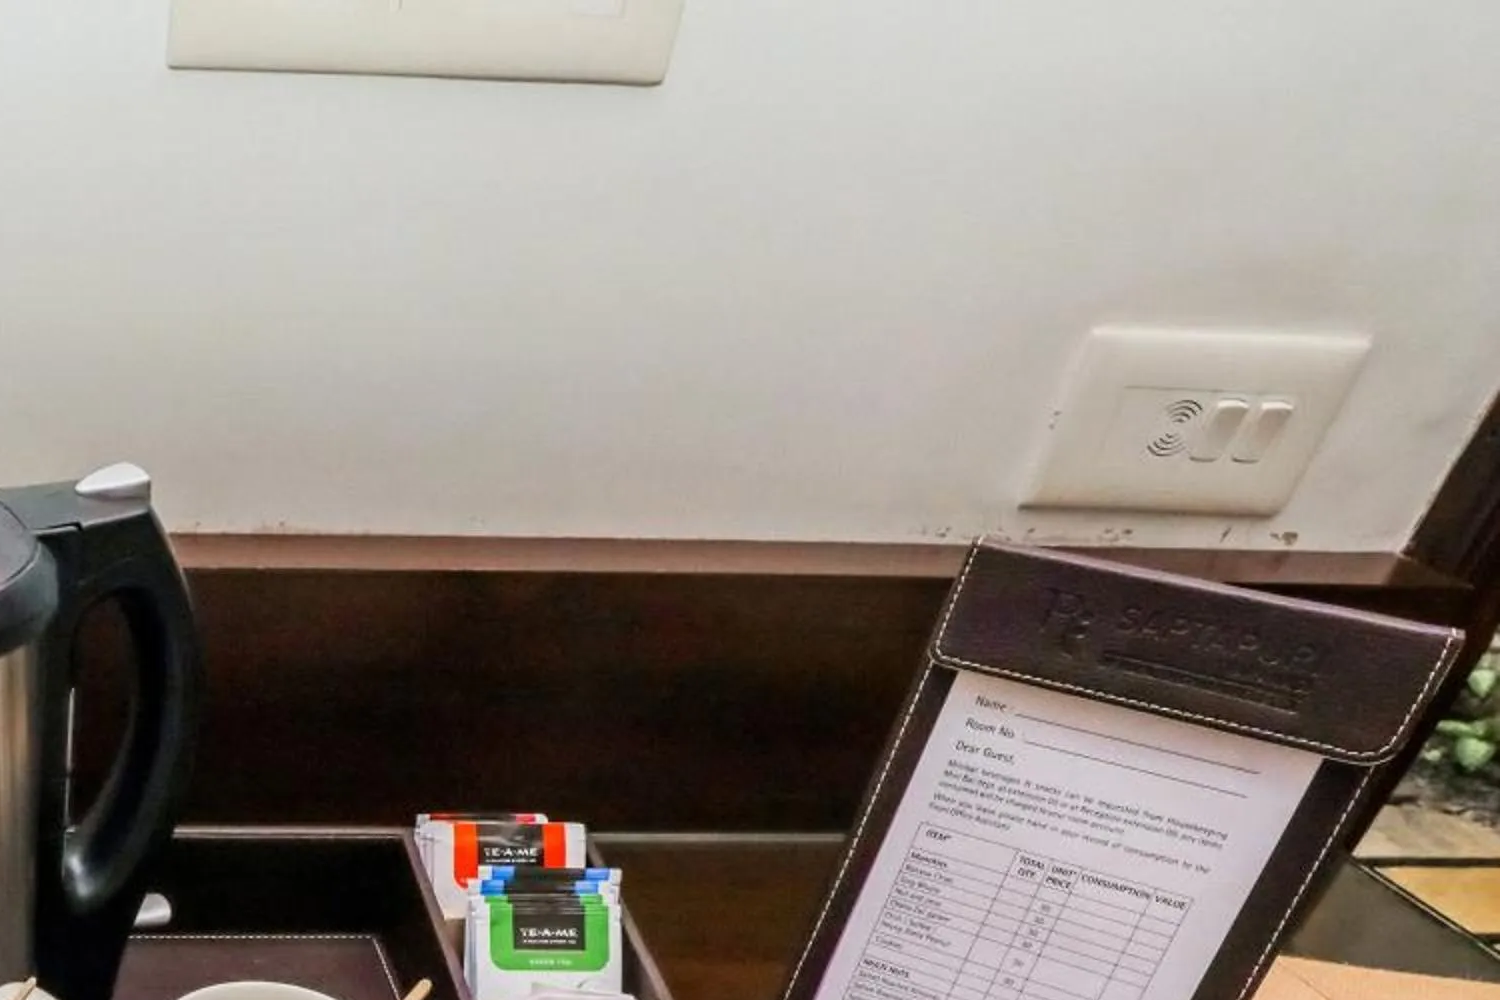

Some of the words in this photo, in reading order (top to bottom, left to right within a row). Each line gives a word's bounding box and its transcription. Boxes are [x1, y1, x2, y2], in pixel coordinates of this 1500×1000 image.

[975, 695, 1007, 711] Name
[965, 718, 996, 733] Room
[955, 740, 981, 755] Dear
[1063, 790, 1081, 801] can
[1081, 795, 1095, 805] be
[1096, 799, 1140, 817] requested
[1139, 810, 1164, 824] from
[1164, 817, 1229, 841] Housekeeping
[1019, 856, 1045, 869] TOTAL
[1045, 876, 1070, 889] PRICE
[1081, 874, 1150, 899] CONSUMPTION
[1154, 895, 1186, 909] VALUE
